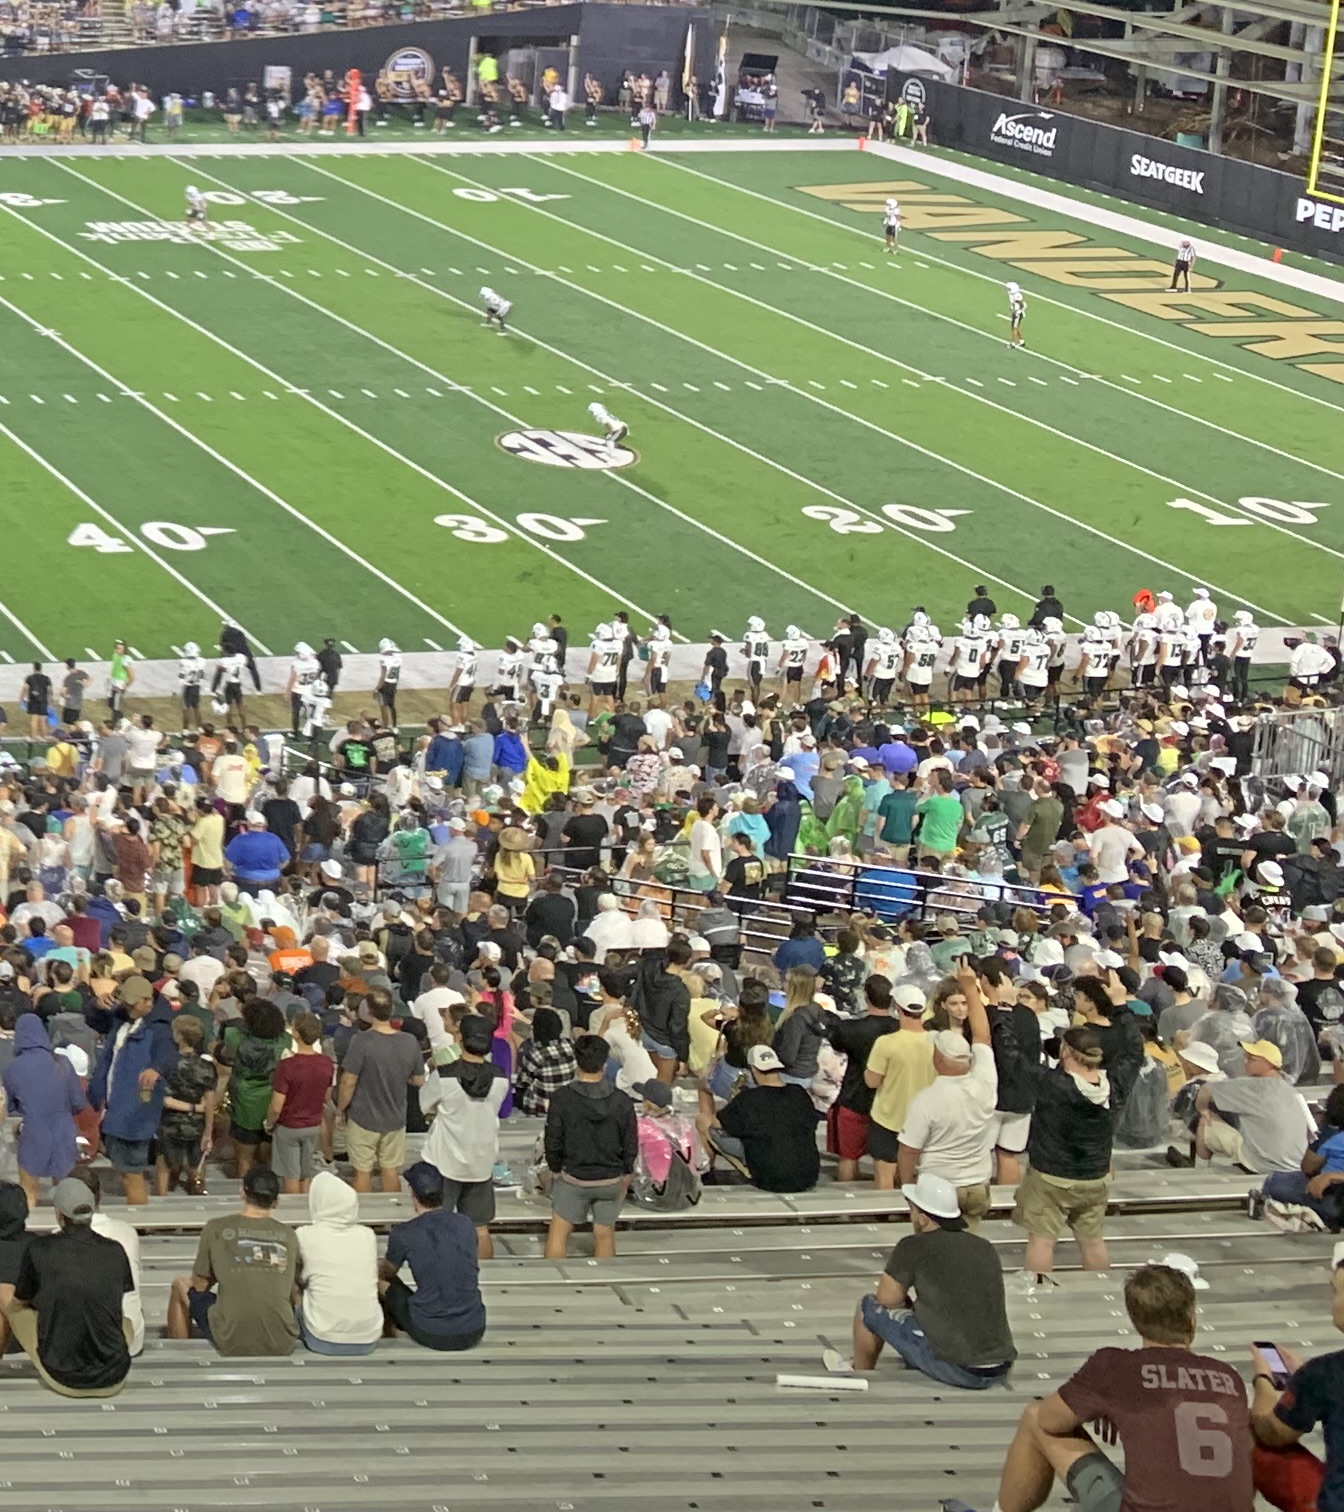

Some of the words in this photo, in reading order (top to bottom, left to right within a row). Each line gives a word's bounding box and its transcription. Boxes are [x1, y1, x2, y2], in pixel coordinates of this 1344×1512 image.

[990, 134, 1014, 147] Federal
[1014, 138, 1033, 152] Credit
[1033, 143, 1053, 157] Union
[992, 114, 1056, 149] Ascend
[1130, 154, 1205, 194] SEATGEEK
[801, 503, 958, 535] 20
[1166, 496, 1321, 526] 10
[67, 522, 207, 553] 40
[433, 512, 587, 544] 30
[1141, 1364, 1240, 1398] SLATER
[1174, 1401, 1233, 1478] 6
